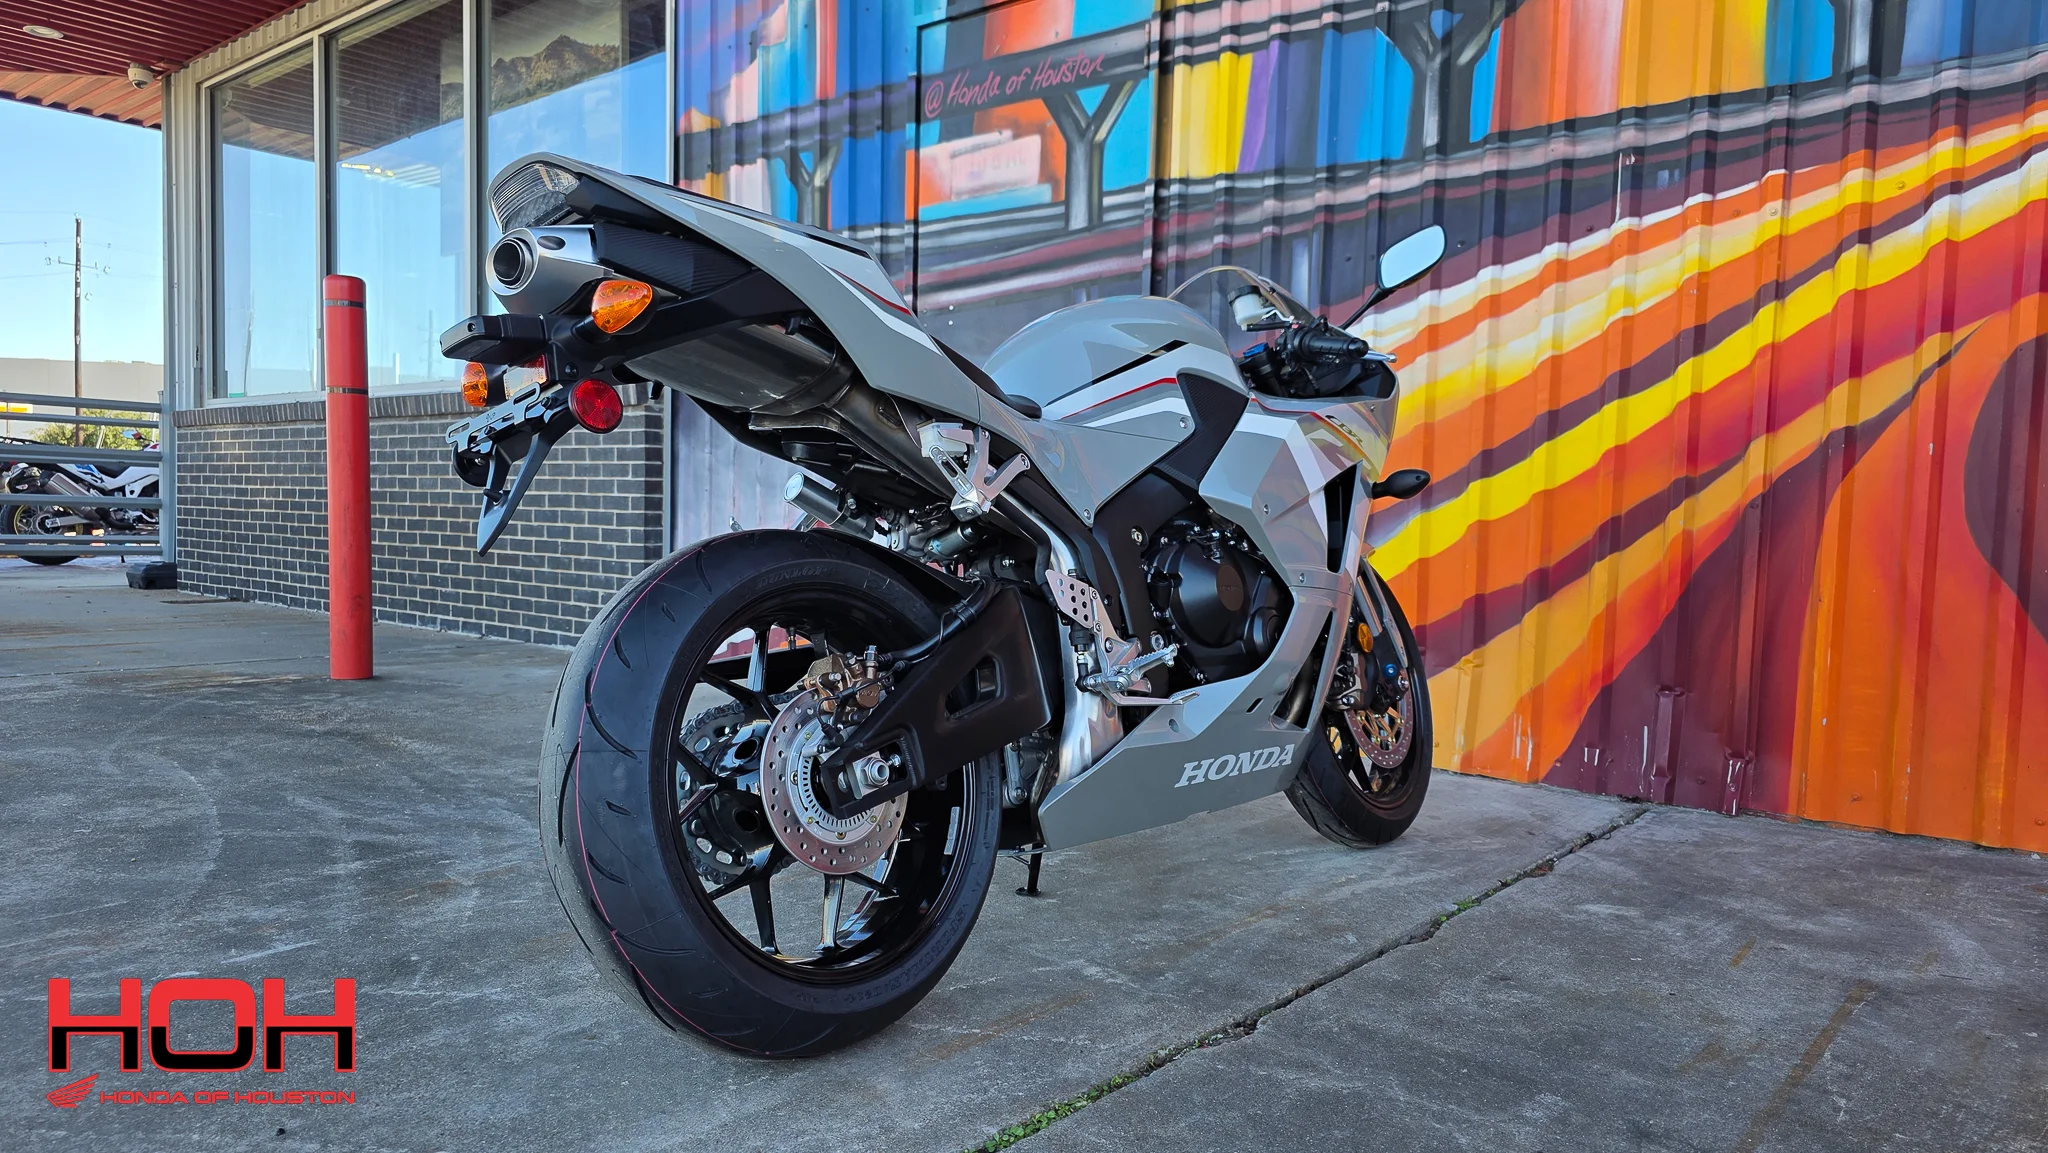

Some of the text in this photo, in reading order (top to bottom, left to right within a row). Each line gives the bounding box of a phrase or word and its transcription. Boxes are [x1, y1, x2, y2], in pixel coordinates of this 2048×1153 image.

[924, 48, 1105, 118] @ Honda of Houston
[1174, 744, 1295, 788] HONDA
